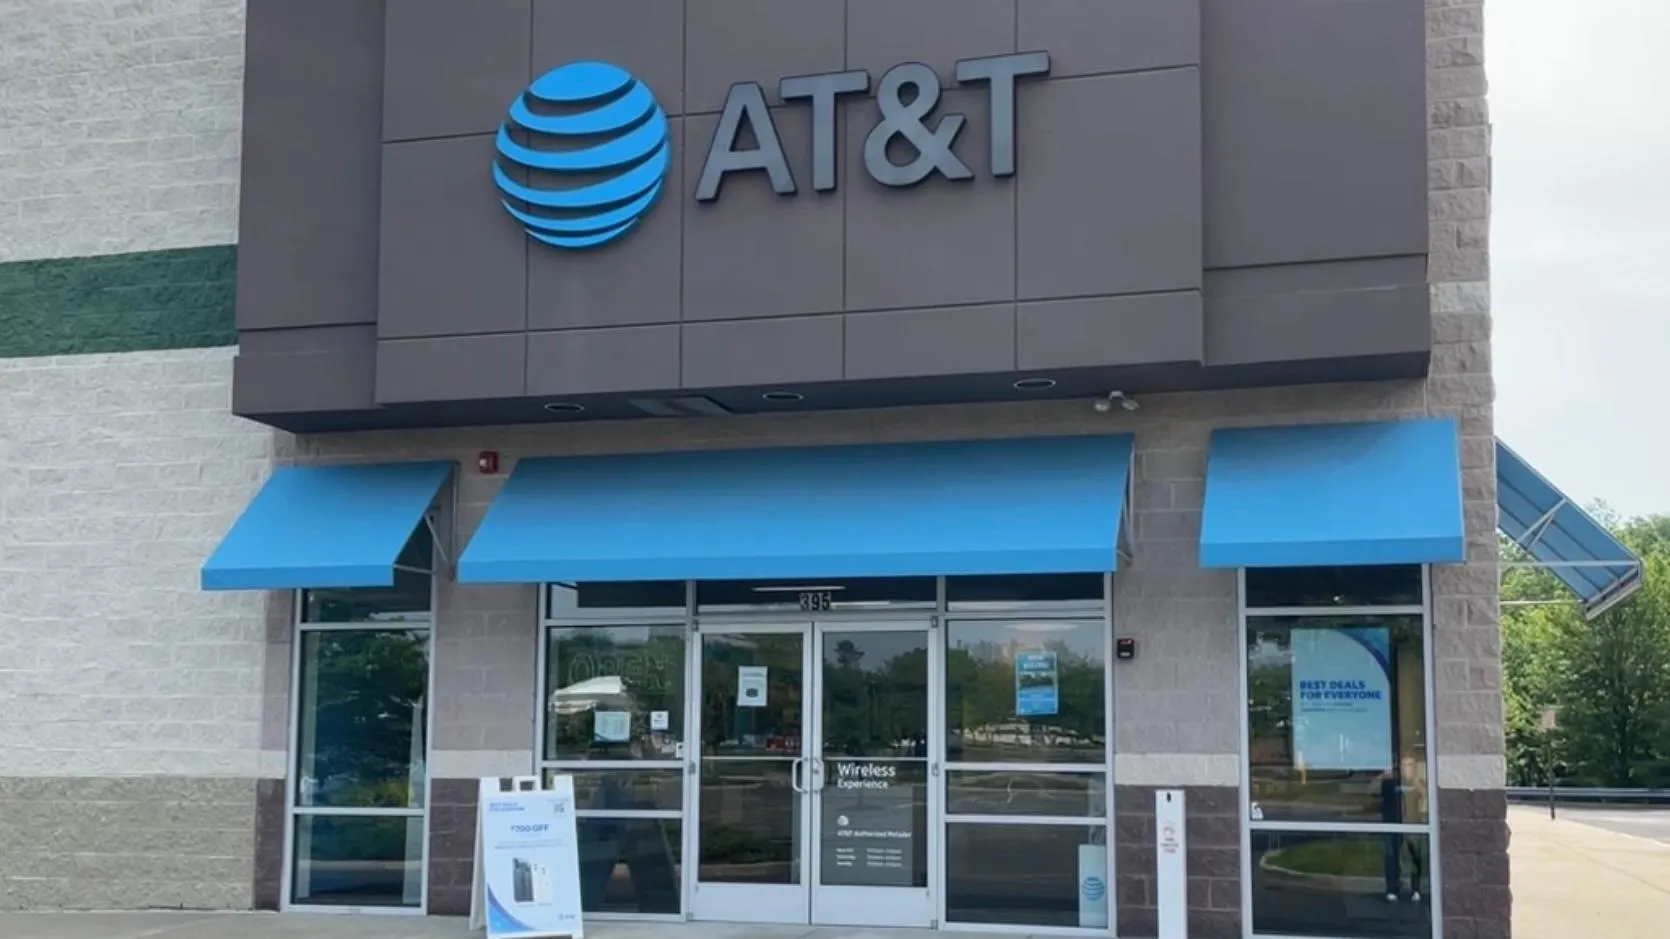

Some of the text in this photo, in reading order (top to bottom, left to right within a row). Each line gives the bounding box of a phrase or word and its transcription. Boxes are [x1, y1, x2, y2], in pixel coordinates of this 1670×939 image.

[696, 50, 1051, 201] AT&T
[800, 591, 831, 611] 395
[1300, 680, 1366, 689] BEST DEALS
[1300, 691, 1382, 700] FOR EVERYONE
[837, 762, 896, 777] Wireless
[837, 779, 888, 790] Experience
